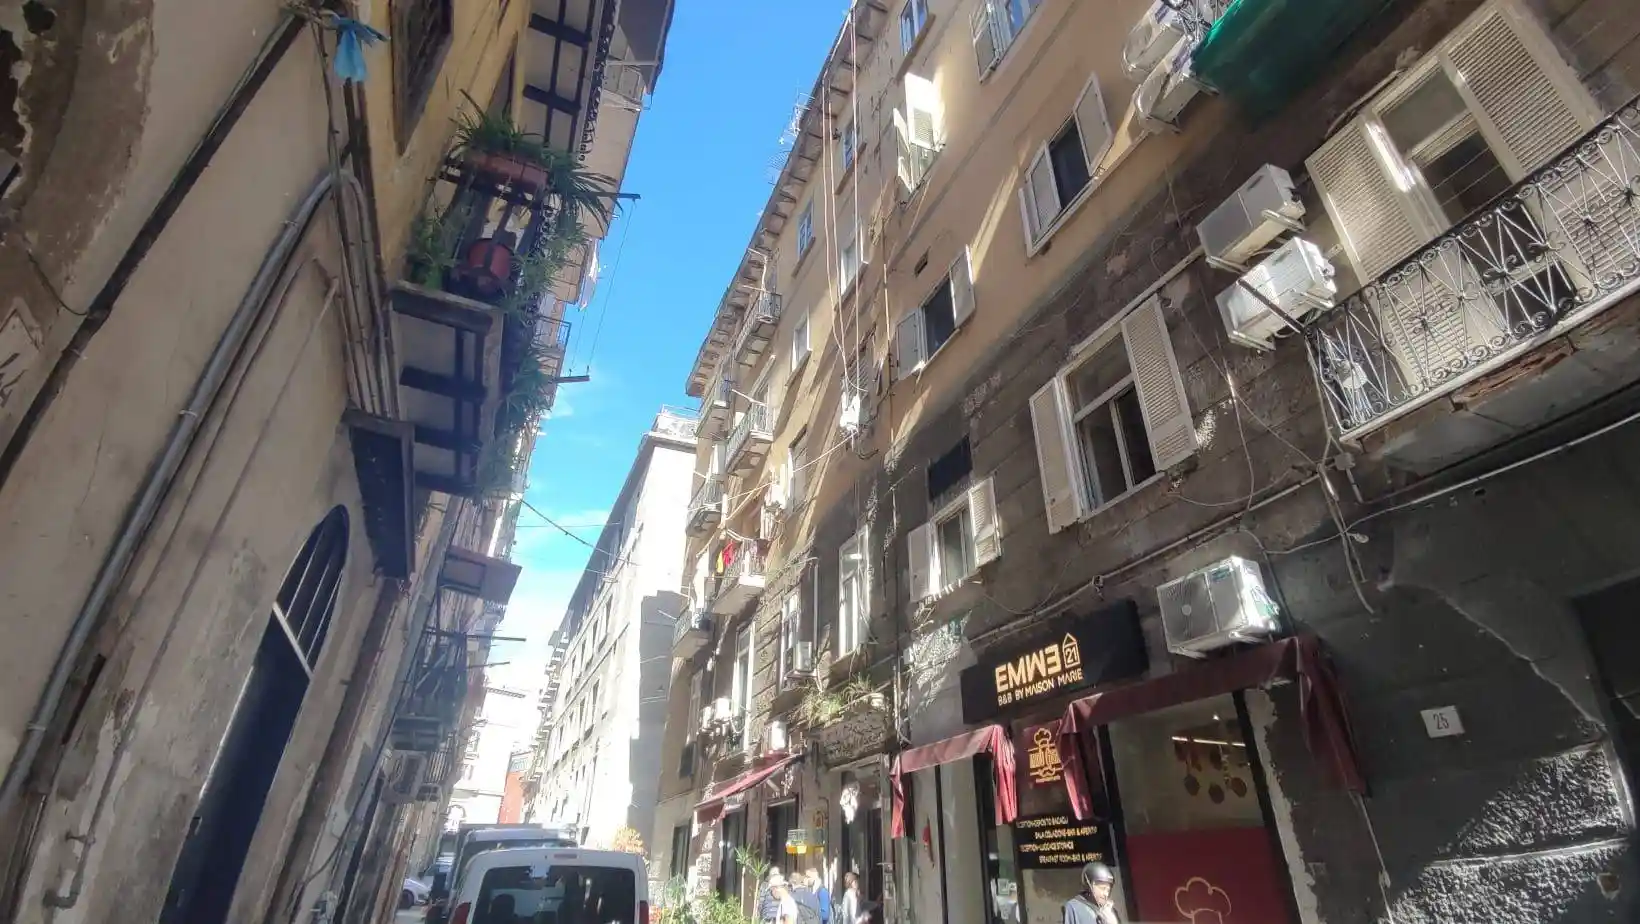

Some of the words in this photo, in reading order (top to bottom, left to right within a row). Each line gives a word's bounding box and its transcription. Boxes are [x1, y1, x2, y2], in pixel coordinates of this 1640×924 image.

[1065, 646, 1079, 664] 21
[997, 692, 1013, 706] B&B
[1015, 688, 1024, 700] BY
[1025, 678, 1055, 697] MAISON
[1057, 668, 1084, 686] MARIE
[1433, 712, 1449, 730] 25
